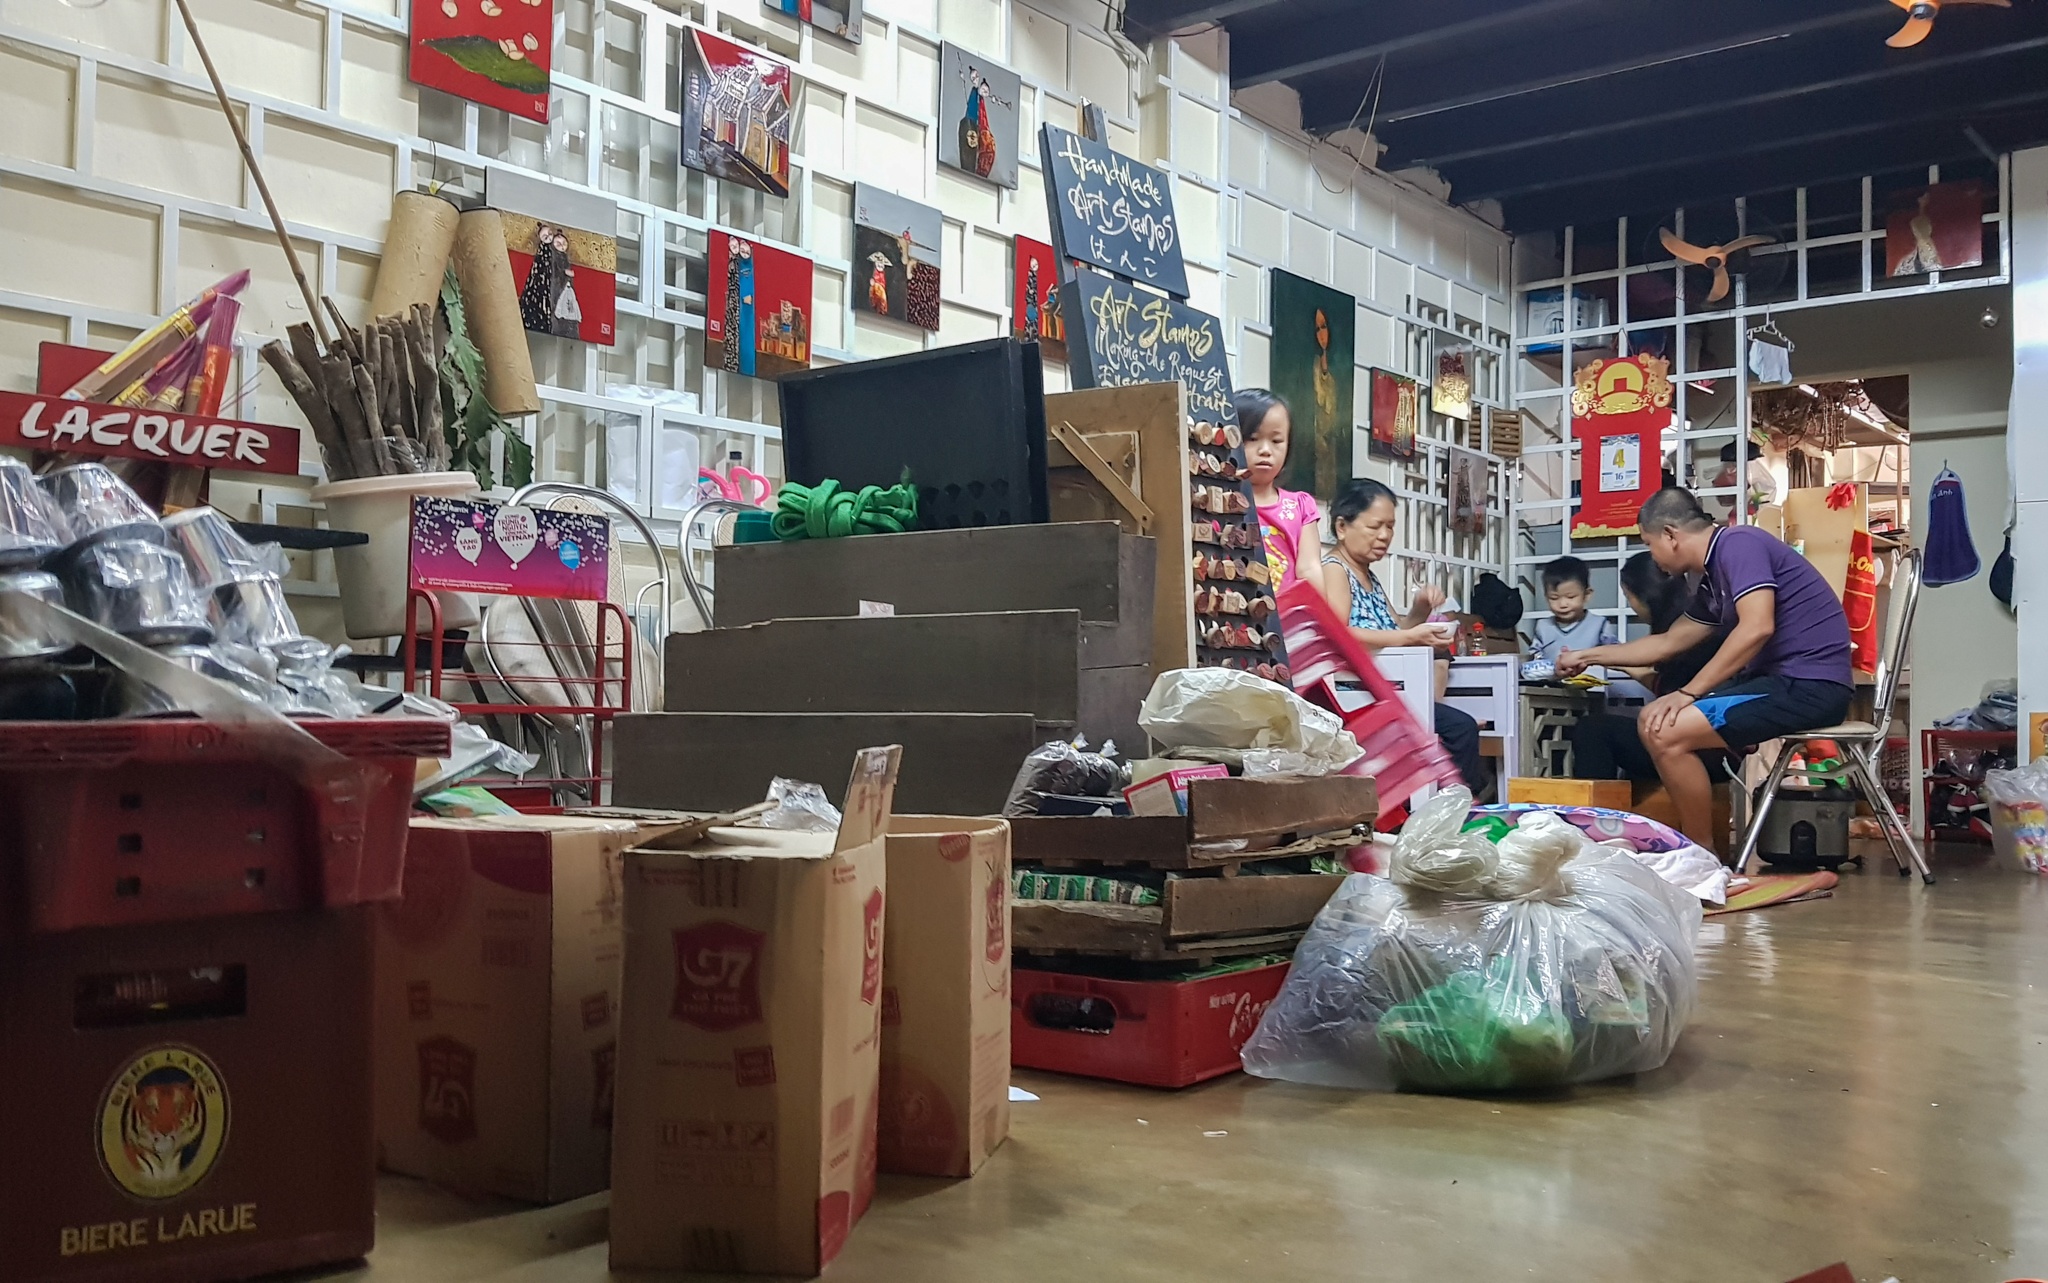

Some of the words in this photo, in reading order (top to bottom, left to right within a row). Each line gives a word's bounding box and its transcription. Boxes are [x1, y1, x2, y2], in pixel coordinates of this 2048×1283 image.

[1067, 182, 1113, 228] Art
[1097, 196, 1174, 256] Stamps
[1090, 285, 1138, 341] Art
[1138, 298, 1213, 362] Stamps
[1168, 351, 1227, 392] Request
[20, 401, 270, 464] LACQUER
[1612, 448, 1625, 468] 4
[1615, 472, 1624, 480] 16
[683, 947, 752, 988] G7
[166, 1052, 216, 1096] LARUE
[60, 1217, 149, 1257] BIERE
[157, 1202, 257, 1243] LARUE
